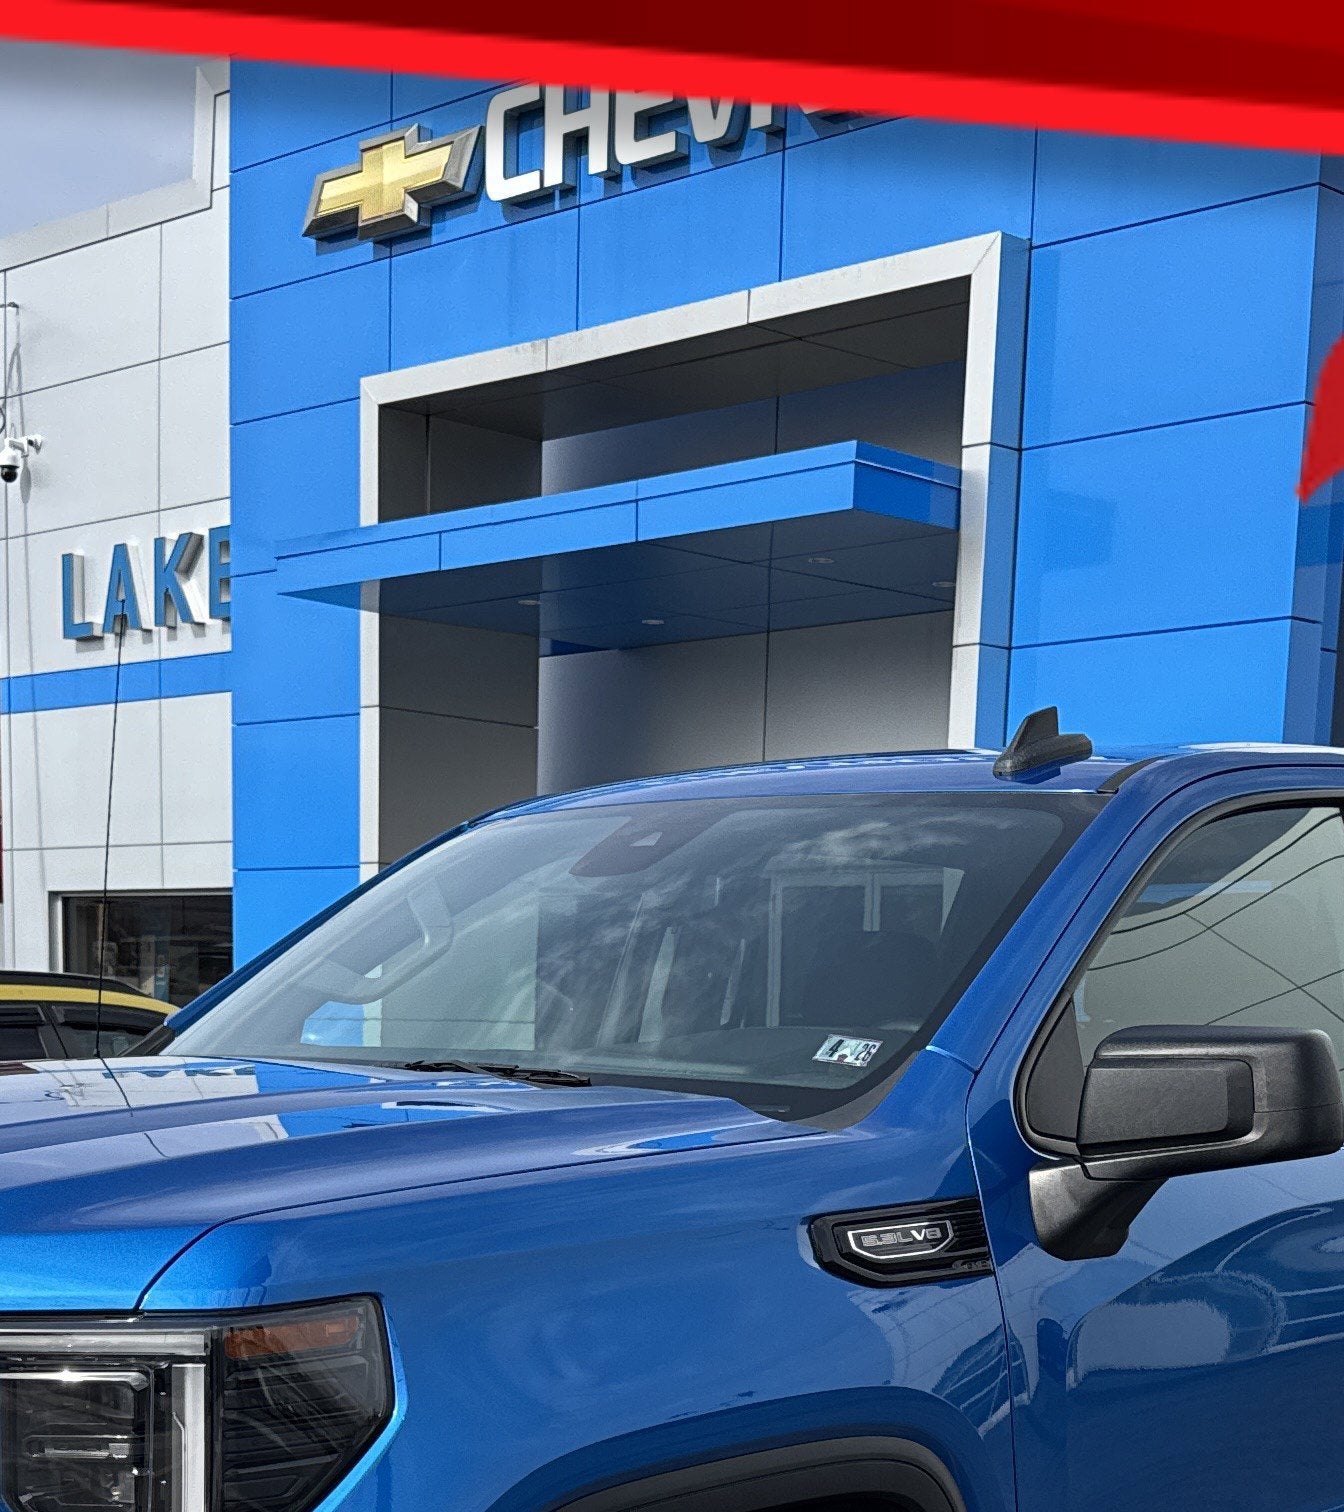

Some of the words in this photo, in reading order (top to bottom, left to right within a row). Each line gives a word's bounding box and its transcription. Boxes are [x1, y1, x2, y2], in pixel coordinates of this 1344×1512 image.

[61, 532, 231, 641] LAKE
[828, 1038, 845, 1058] 4
[854, 1042, 877, 1062] 26
